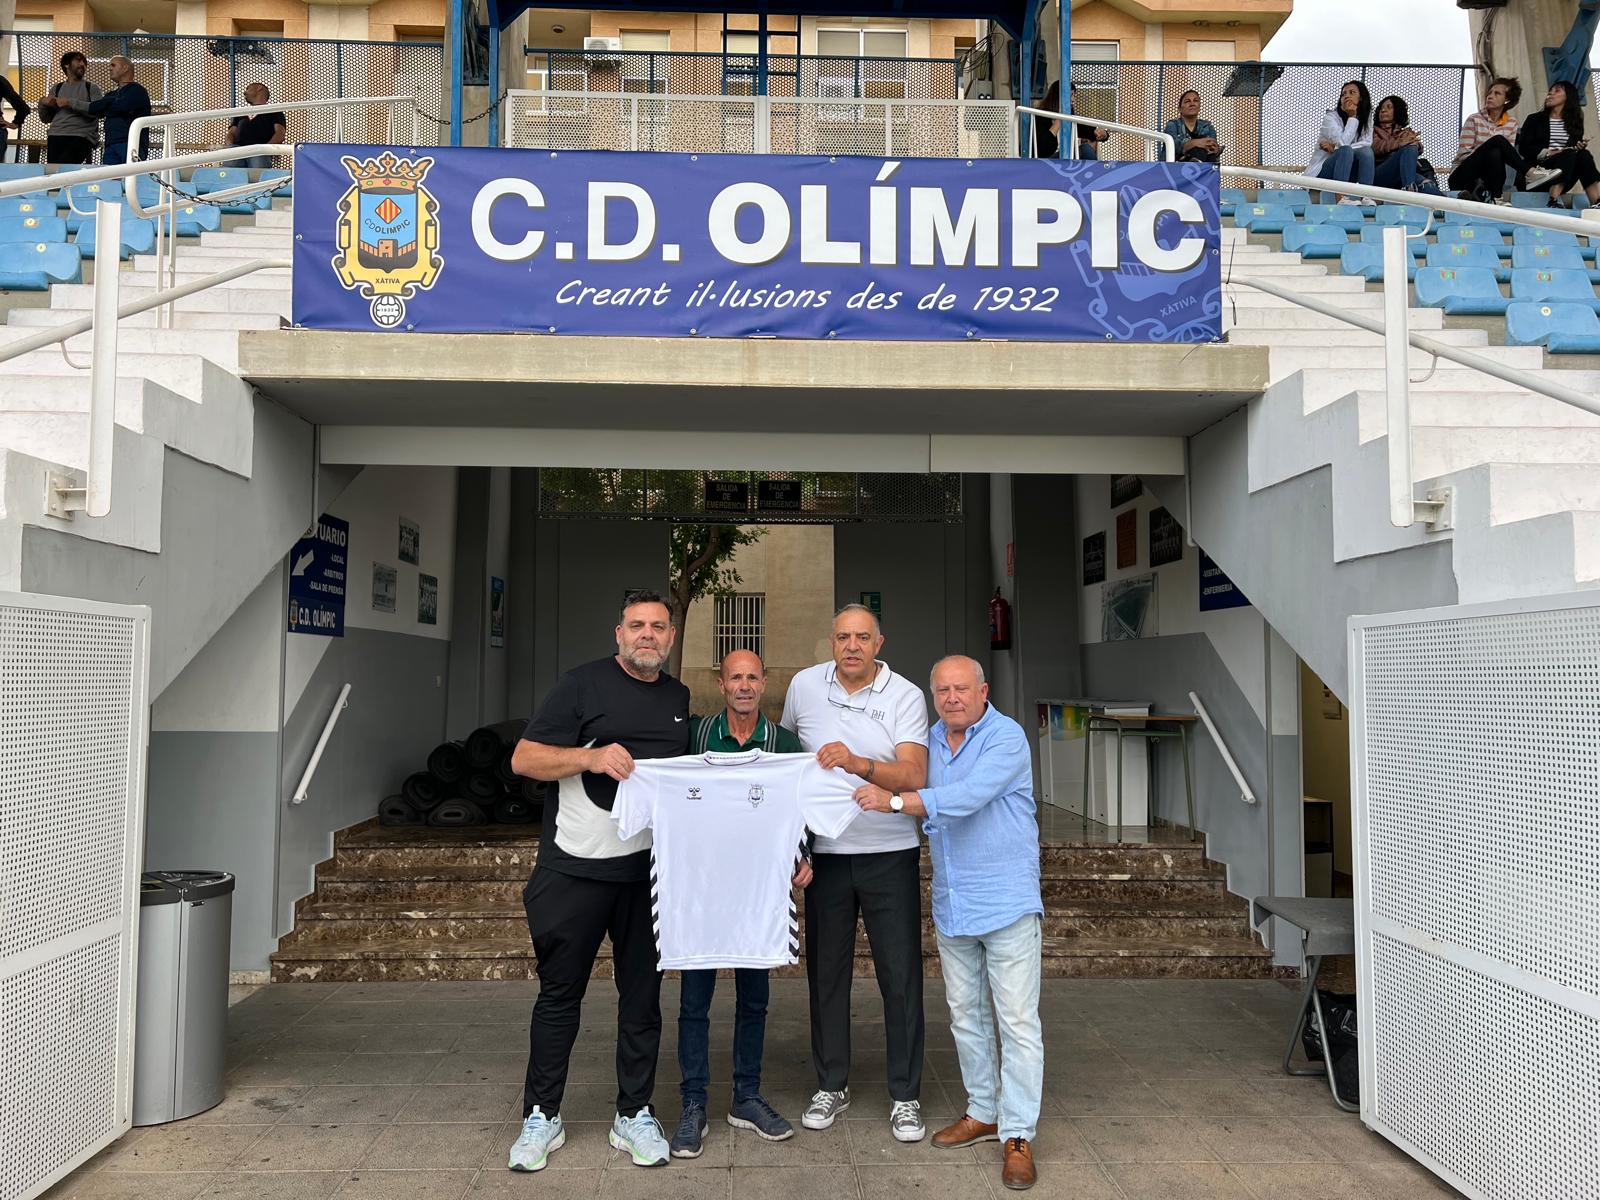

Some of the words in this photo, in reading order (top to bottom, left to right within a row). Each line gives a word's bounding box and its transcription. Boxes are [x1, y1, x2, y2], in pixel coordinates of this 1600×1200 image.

[471, 178, 681, 272] C.D.
[708, 163, 1207, 272] OLÍMPIC
[555, 279, 672, 307] Creant
[846, 281, 903, 311] des
[917, 283, 957, 311] de
[973, 286, 1061, 313] 1932
[716, 484, 738, 492] SALIDA
[722, 492, 732, 500] DE
[706, 501, 746, 510] EMERGENCIA
[312, 604, 336, 629] OLÍMPIC
